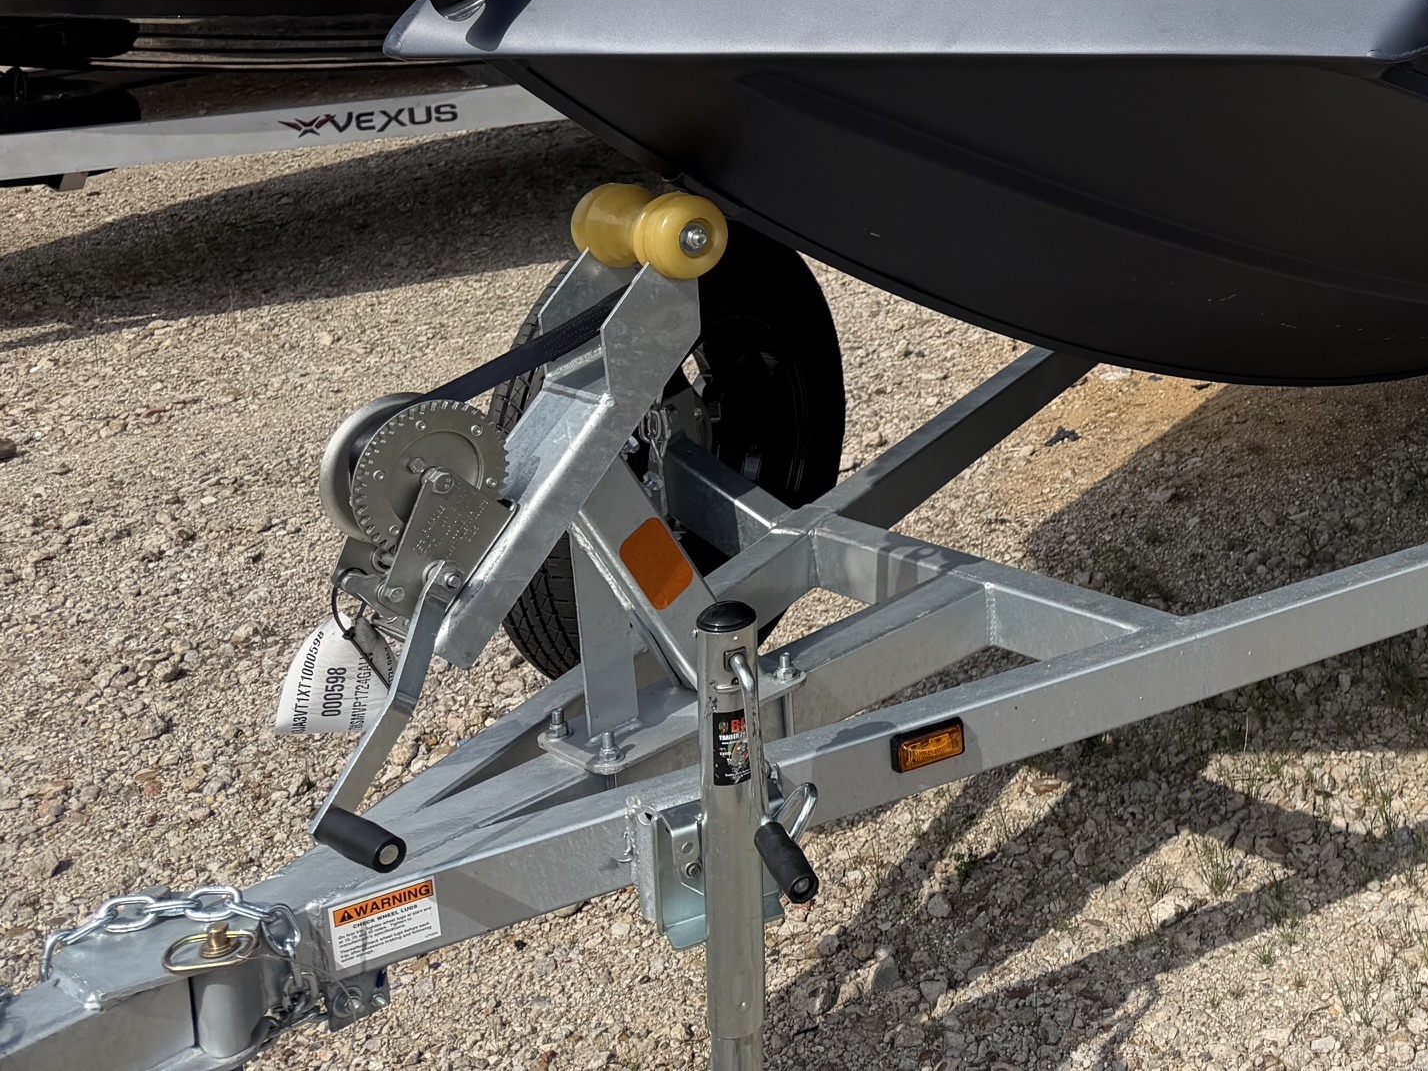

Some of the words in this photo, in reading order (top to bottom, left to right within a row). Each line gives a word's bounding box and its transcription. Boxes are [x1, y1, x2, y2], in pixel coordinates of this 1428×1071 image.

[326, 103, 459, 134] VEXUS
[321, 667, 347, 717] 000598
[353, 884, 430, 917] WARNING
[377, 911, 398, 920] WHEEL
